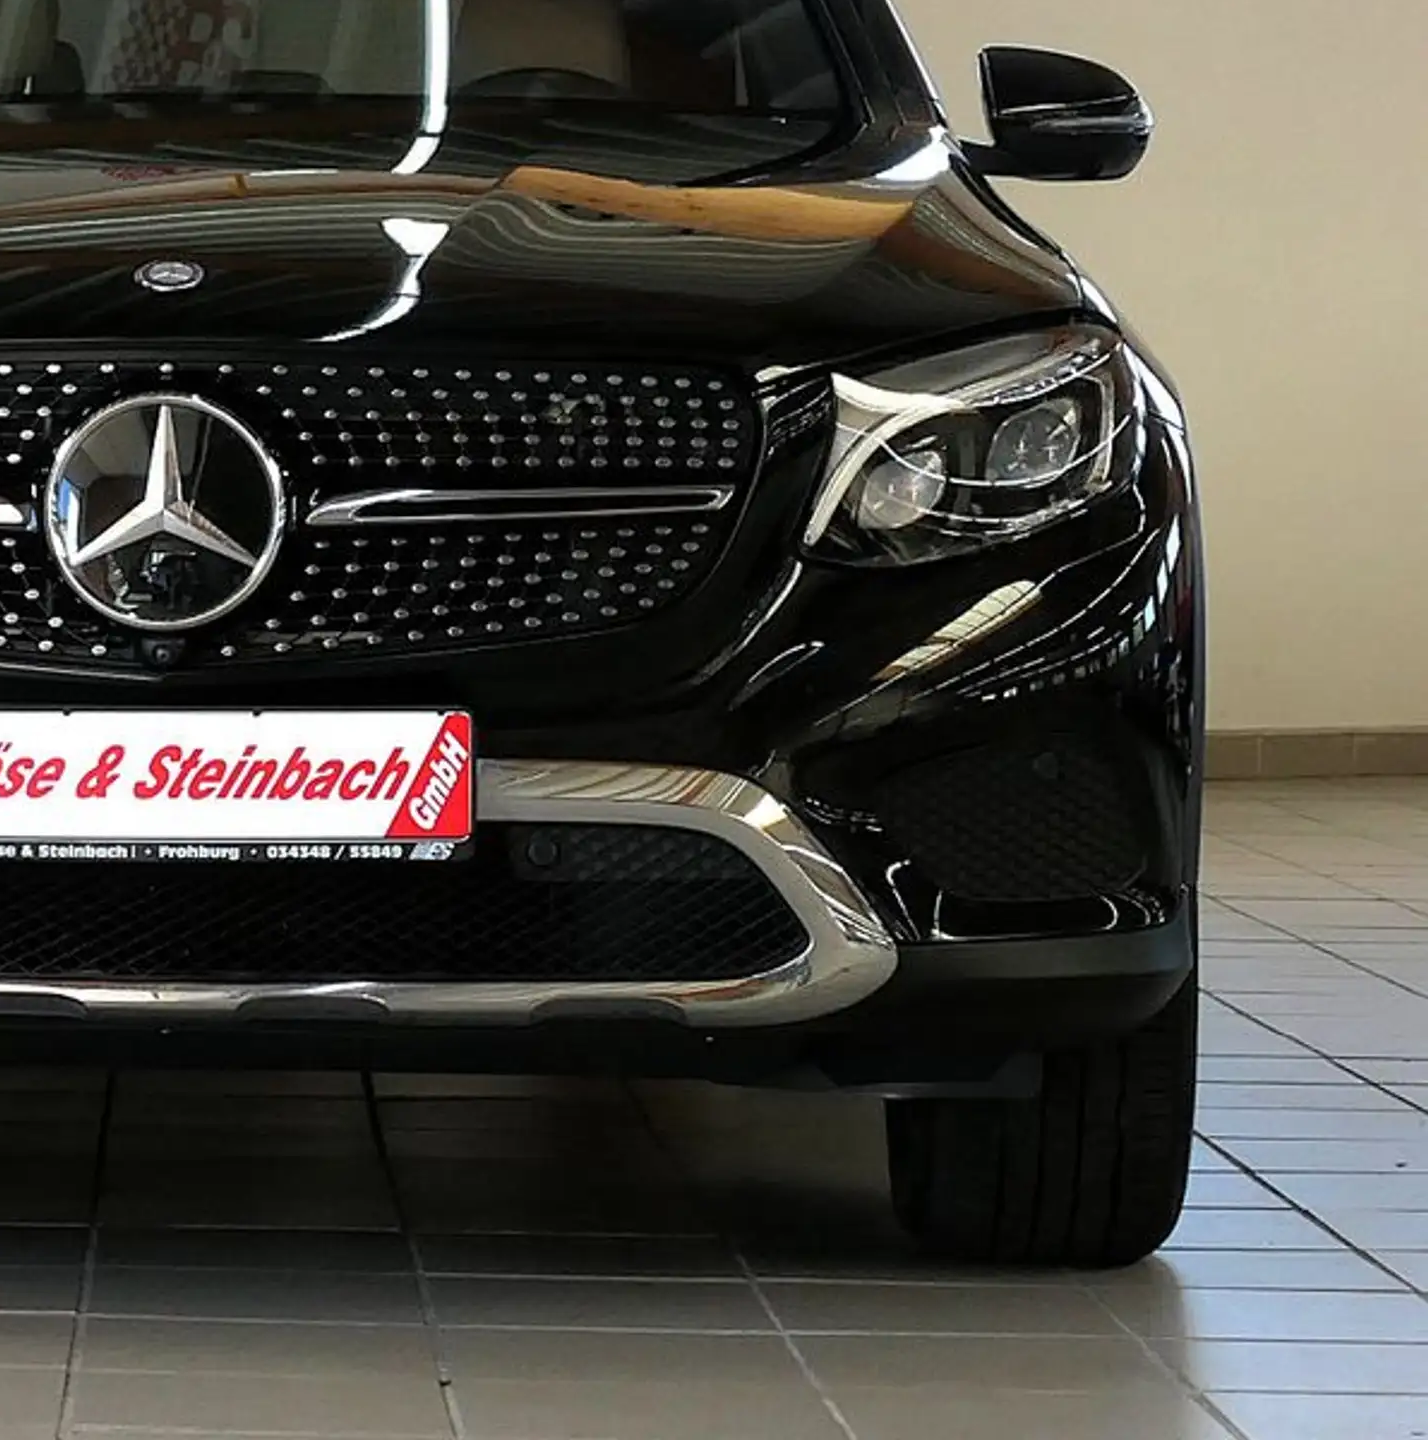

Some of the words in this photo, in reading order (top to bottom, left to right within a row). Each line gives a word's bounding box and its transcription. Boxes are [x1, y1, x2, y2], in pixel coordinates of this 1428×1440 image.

[75, 744, 127, 799] &
[133, 744, 411, 800] Steinbach
[408, 730, 469, 831] GmbH
[21, 843, 34, 858] &
[158, 844, 239, 862] Frohburg
